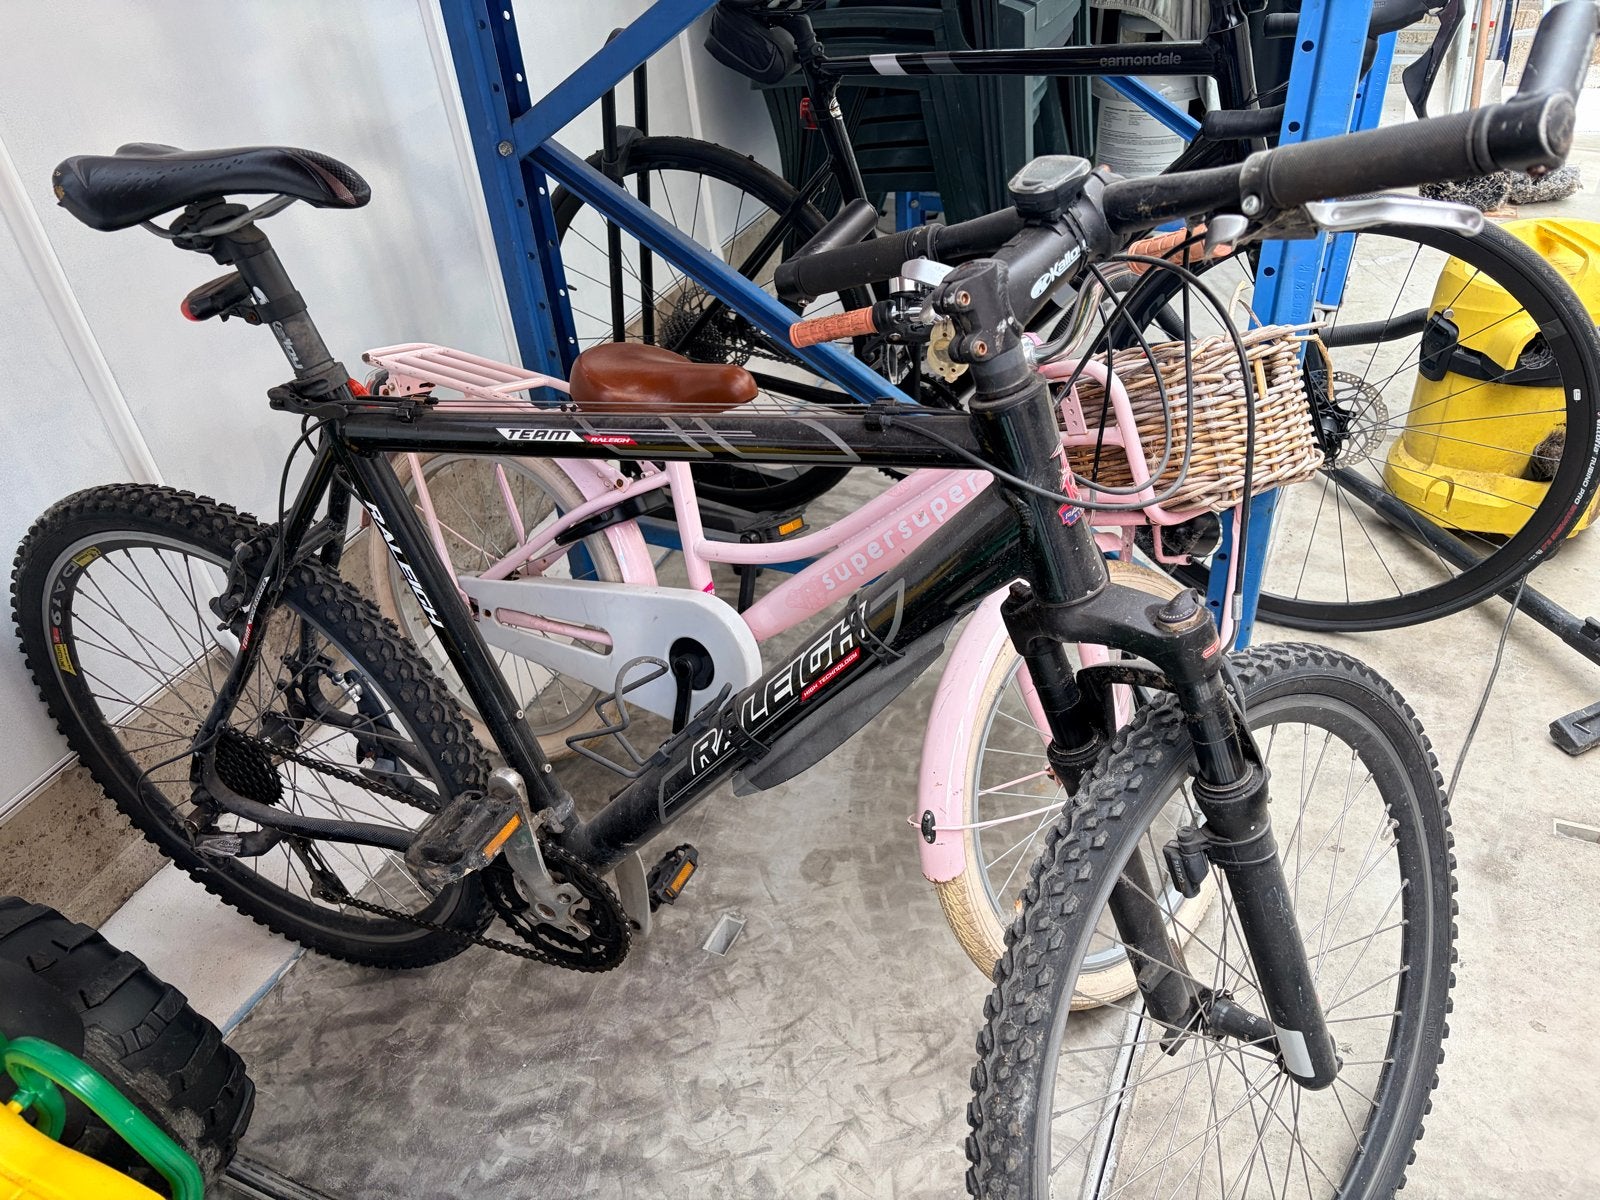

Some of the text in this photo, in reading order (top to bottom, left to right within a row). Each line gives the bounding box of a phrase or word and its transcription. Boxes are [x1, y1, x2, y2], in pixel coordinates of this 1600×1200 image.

[1100, 52, 1182, 66] cannondale
[508, 428, 632, 444] TEAM RALEIGH
[821, 472, 978, 592] supersuper
[362, 498, 445, 629] RALEIGH
[803, 651, 858, 697] HIGH TECHNOLOGY
